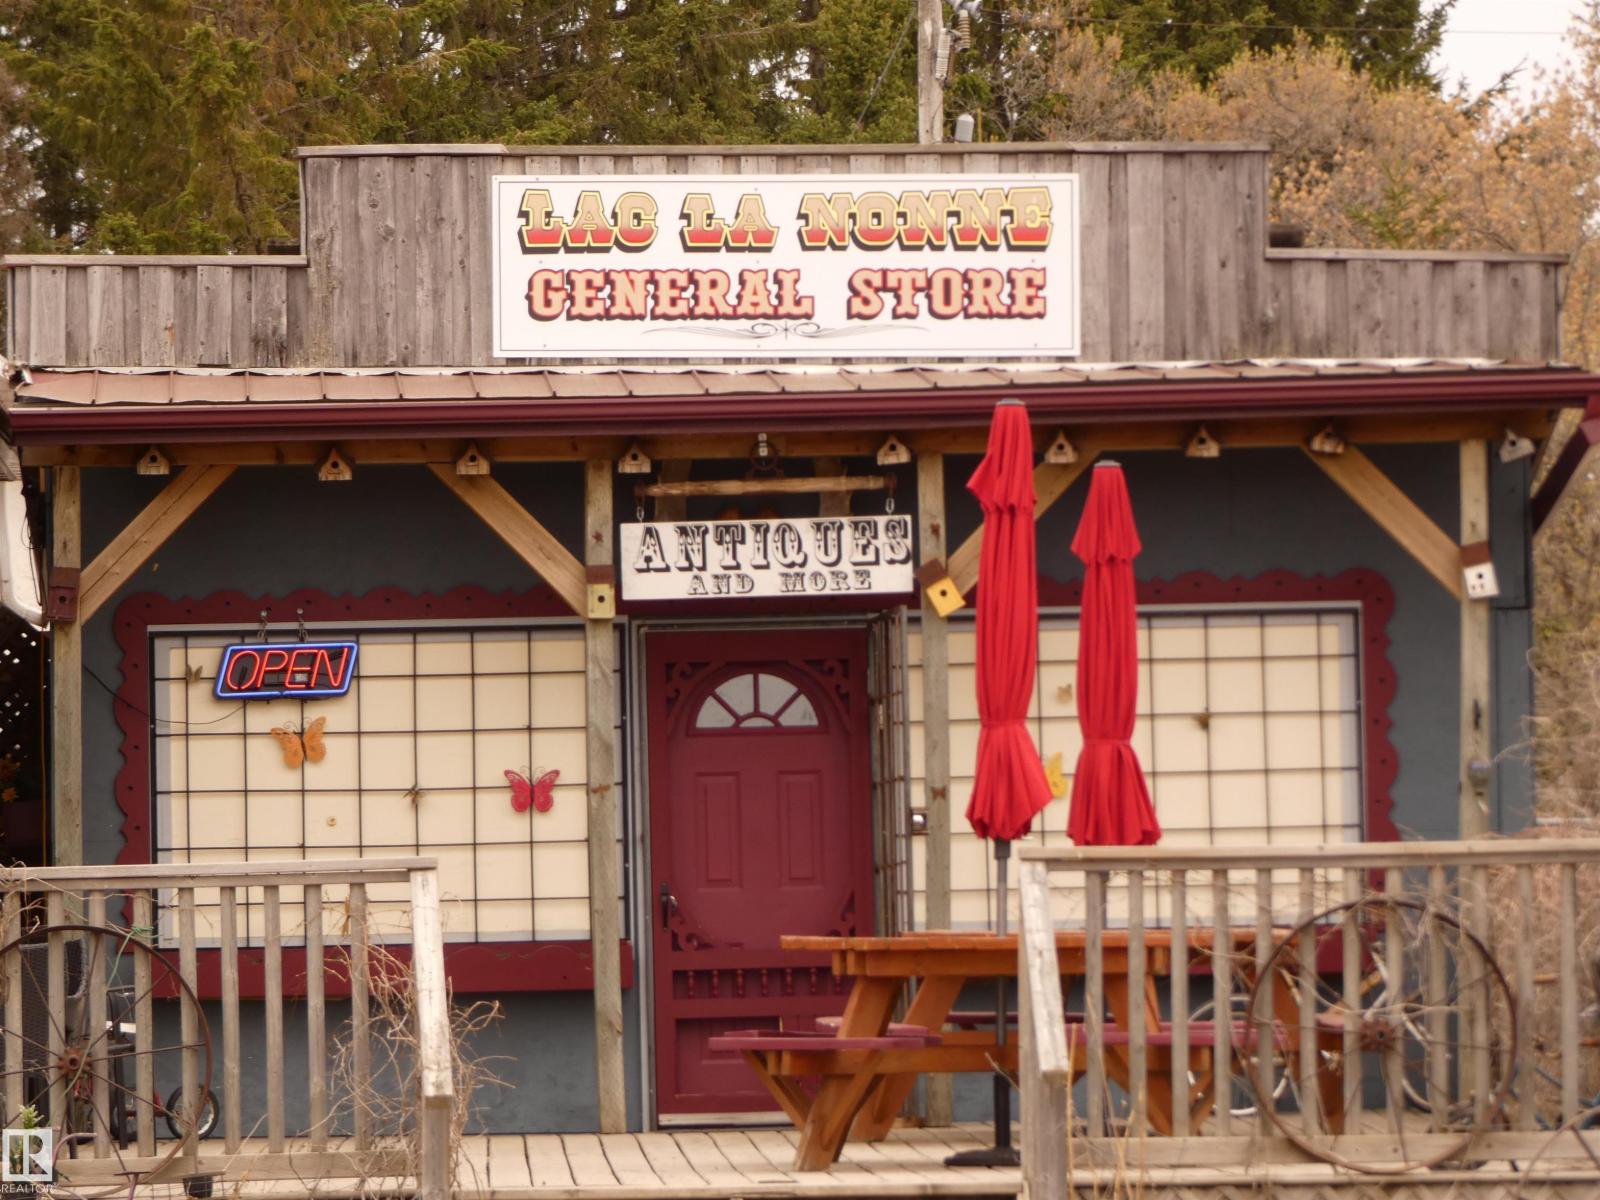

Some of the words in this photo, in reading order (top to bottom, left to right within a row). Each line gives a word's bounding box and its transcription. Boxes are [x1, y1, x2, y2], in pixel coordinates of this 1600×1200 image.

[518, 189, 659, 254] LAC
[681, 192, 778, 253] LA
[797, 186, 1054, 252] NONNE
[526, 268, 815, 321] GENERAL
[846, 266, 1047, 320] STORE
[633, 516, 913, 573] ANTIQUES
[687, 574, 755, 596] AND
[778, 569, 873, 593] MORE
[226, 647, 349, 690] OPEN
